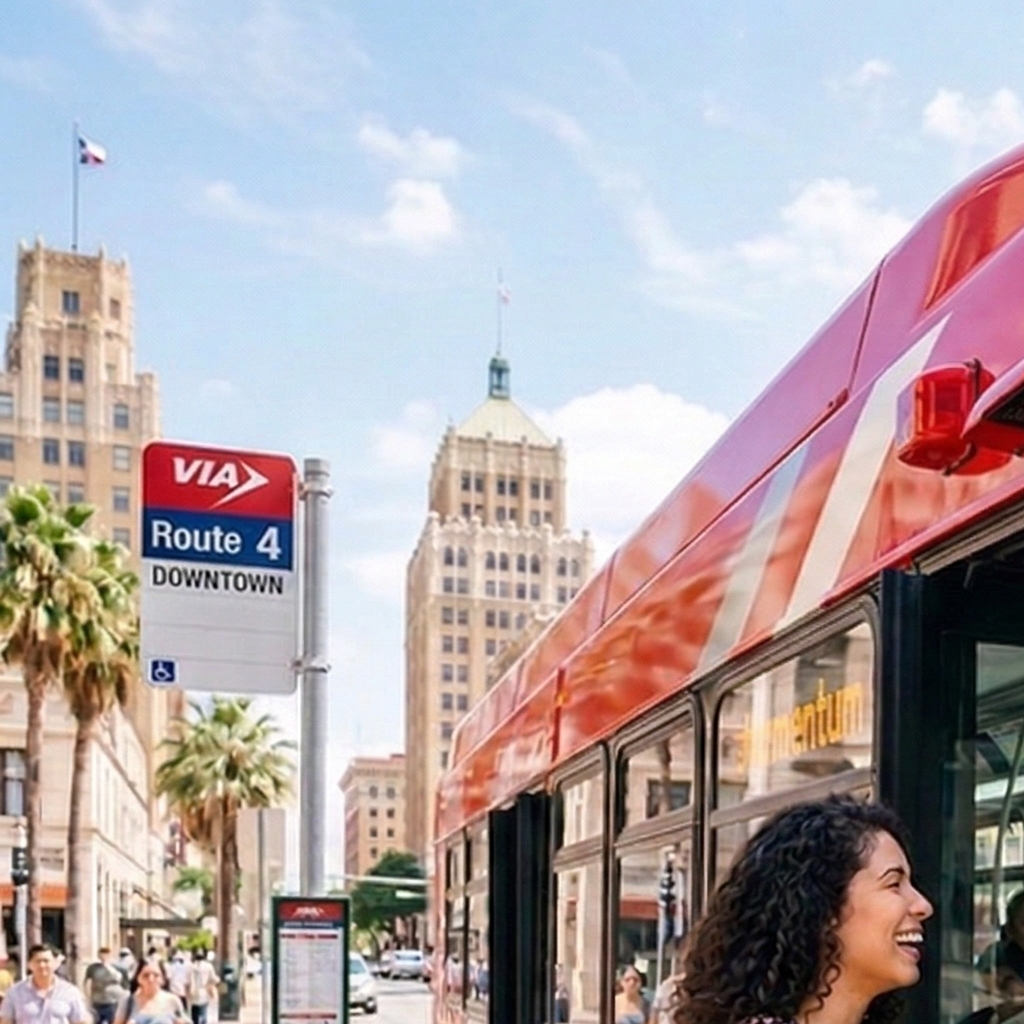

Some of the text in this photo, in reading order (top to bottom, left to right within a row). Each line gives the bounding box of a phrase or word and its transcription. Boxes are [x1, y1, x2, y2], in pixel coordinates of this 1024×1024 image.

[173, 457, 239, 488] VIA
[152, 520, 282, 560] Route 4
[153, 565, 283, 595] DOWNTOWN
[738, 678, 863, 772] mentum
